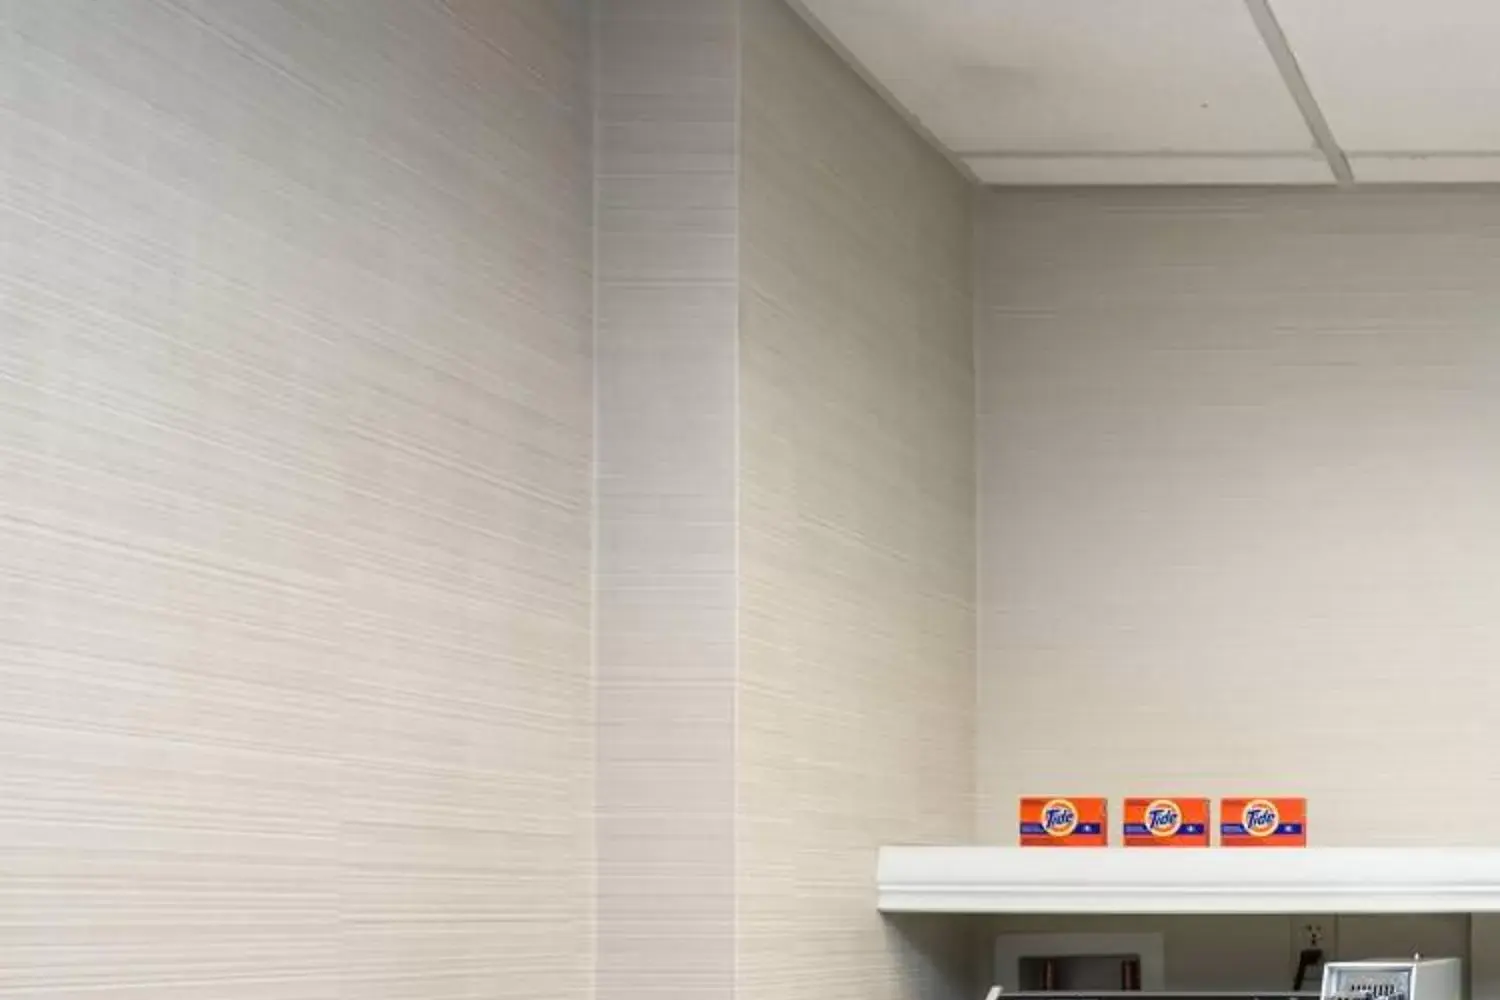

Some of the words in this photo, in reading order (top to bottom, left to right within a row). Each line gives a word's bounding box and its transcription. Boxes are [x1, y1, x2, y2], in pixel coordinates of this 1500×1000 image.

[1045, 807, 1075, 829] Tide
[1148, 807, 1178, 829] Tide
[1247, 807, 1276, 829] Tide
